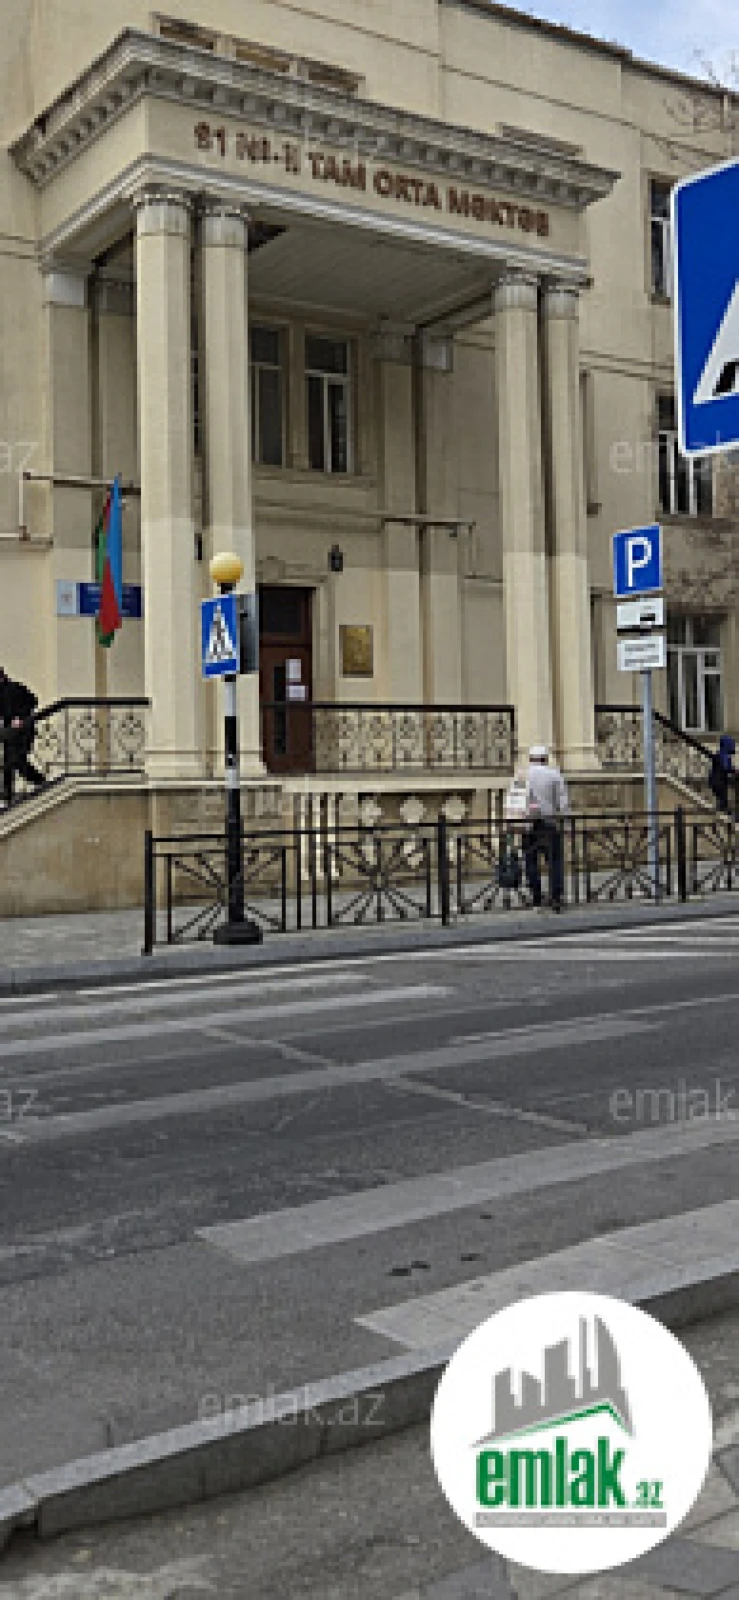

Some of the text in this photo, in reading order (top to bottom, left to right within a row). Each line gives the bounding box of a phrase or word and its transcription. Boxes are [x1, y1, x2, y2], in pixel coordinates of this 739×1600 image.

[306, 152, 366, 191] TAM
[373, 170, 442, 210] ORTA
[626, 537, 652, 587] P
